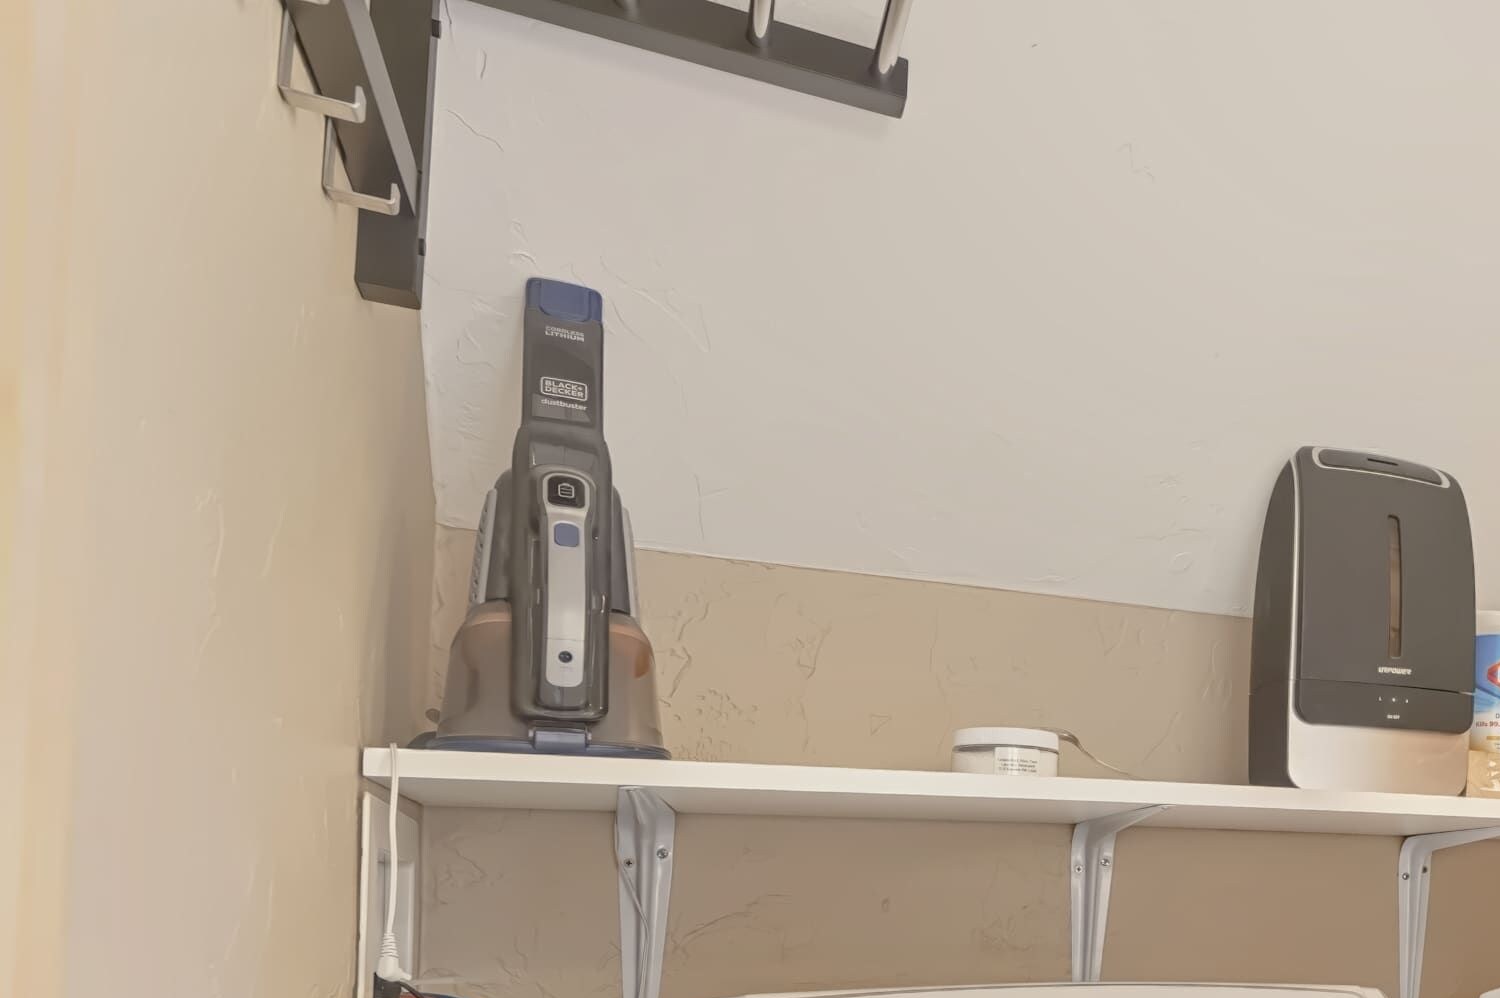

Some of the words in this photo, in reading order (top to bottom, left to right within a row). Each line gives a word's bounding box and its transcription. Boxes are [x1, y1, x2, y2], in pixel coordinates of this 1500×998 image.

[545, 331, 584, 342] LITHIUM
[545, 380, 583, 391] BLACK+
[545, 386, 584, 398] DECKER
[541, 399, 587, 411] dustbuster
